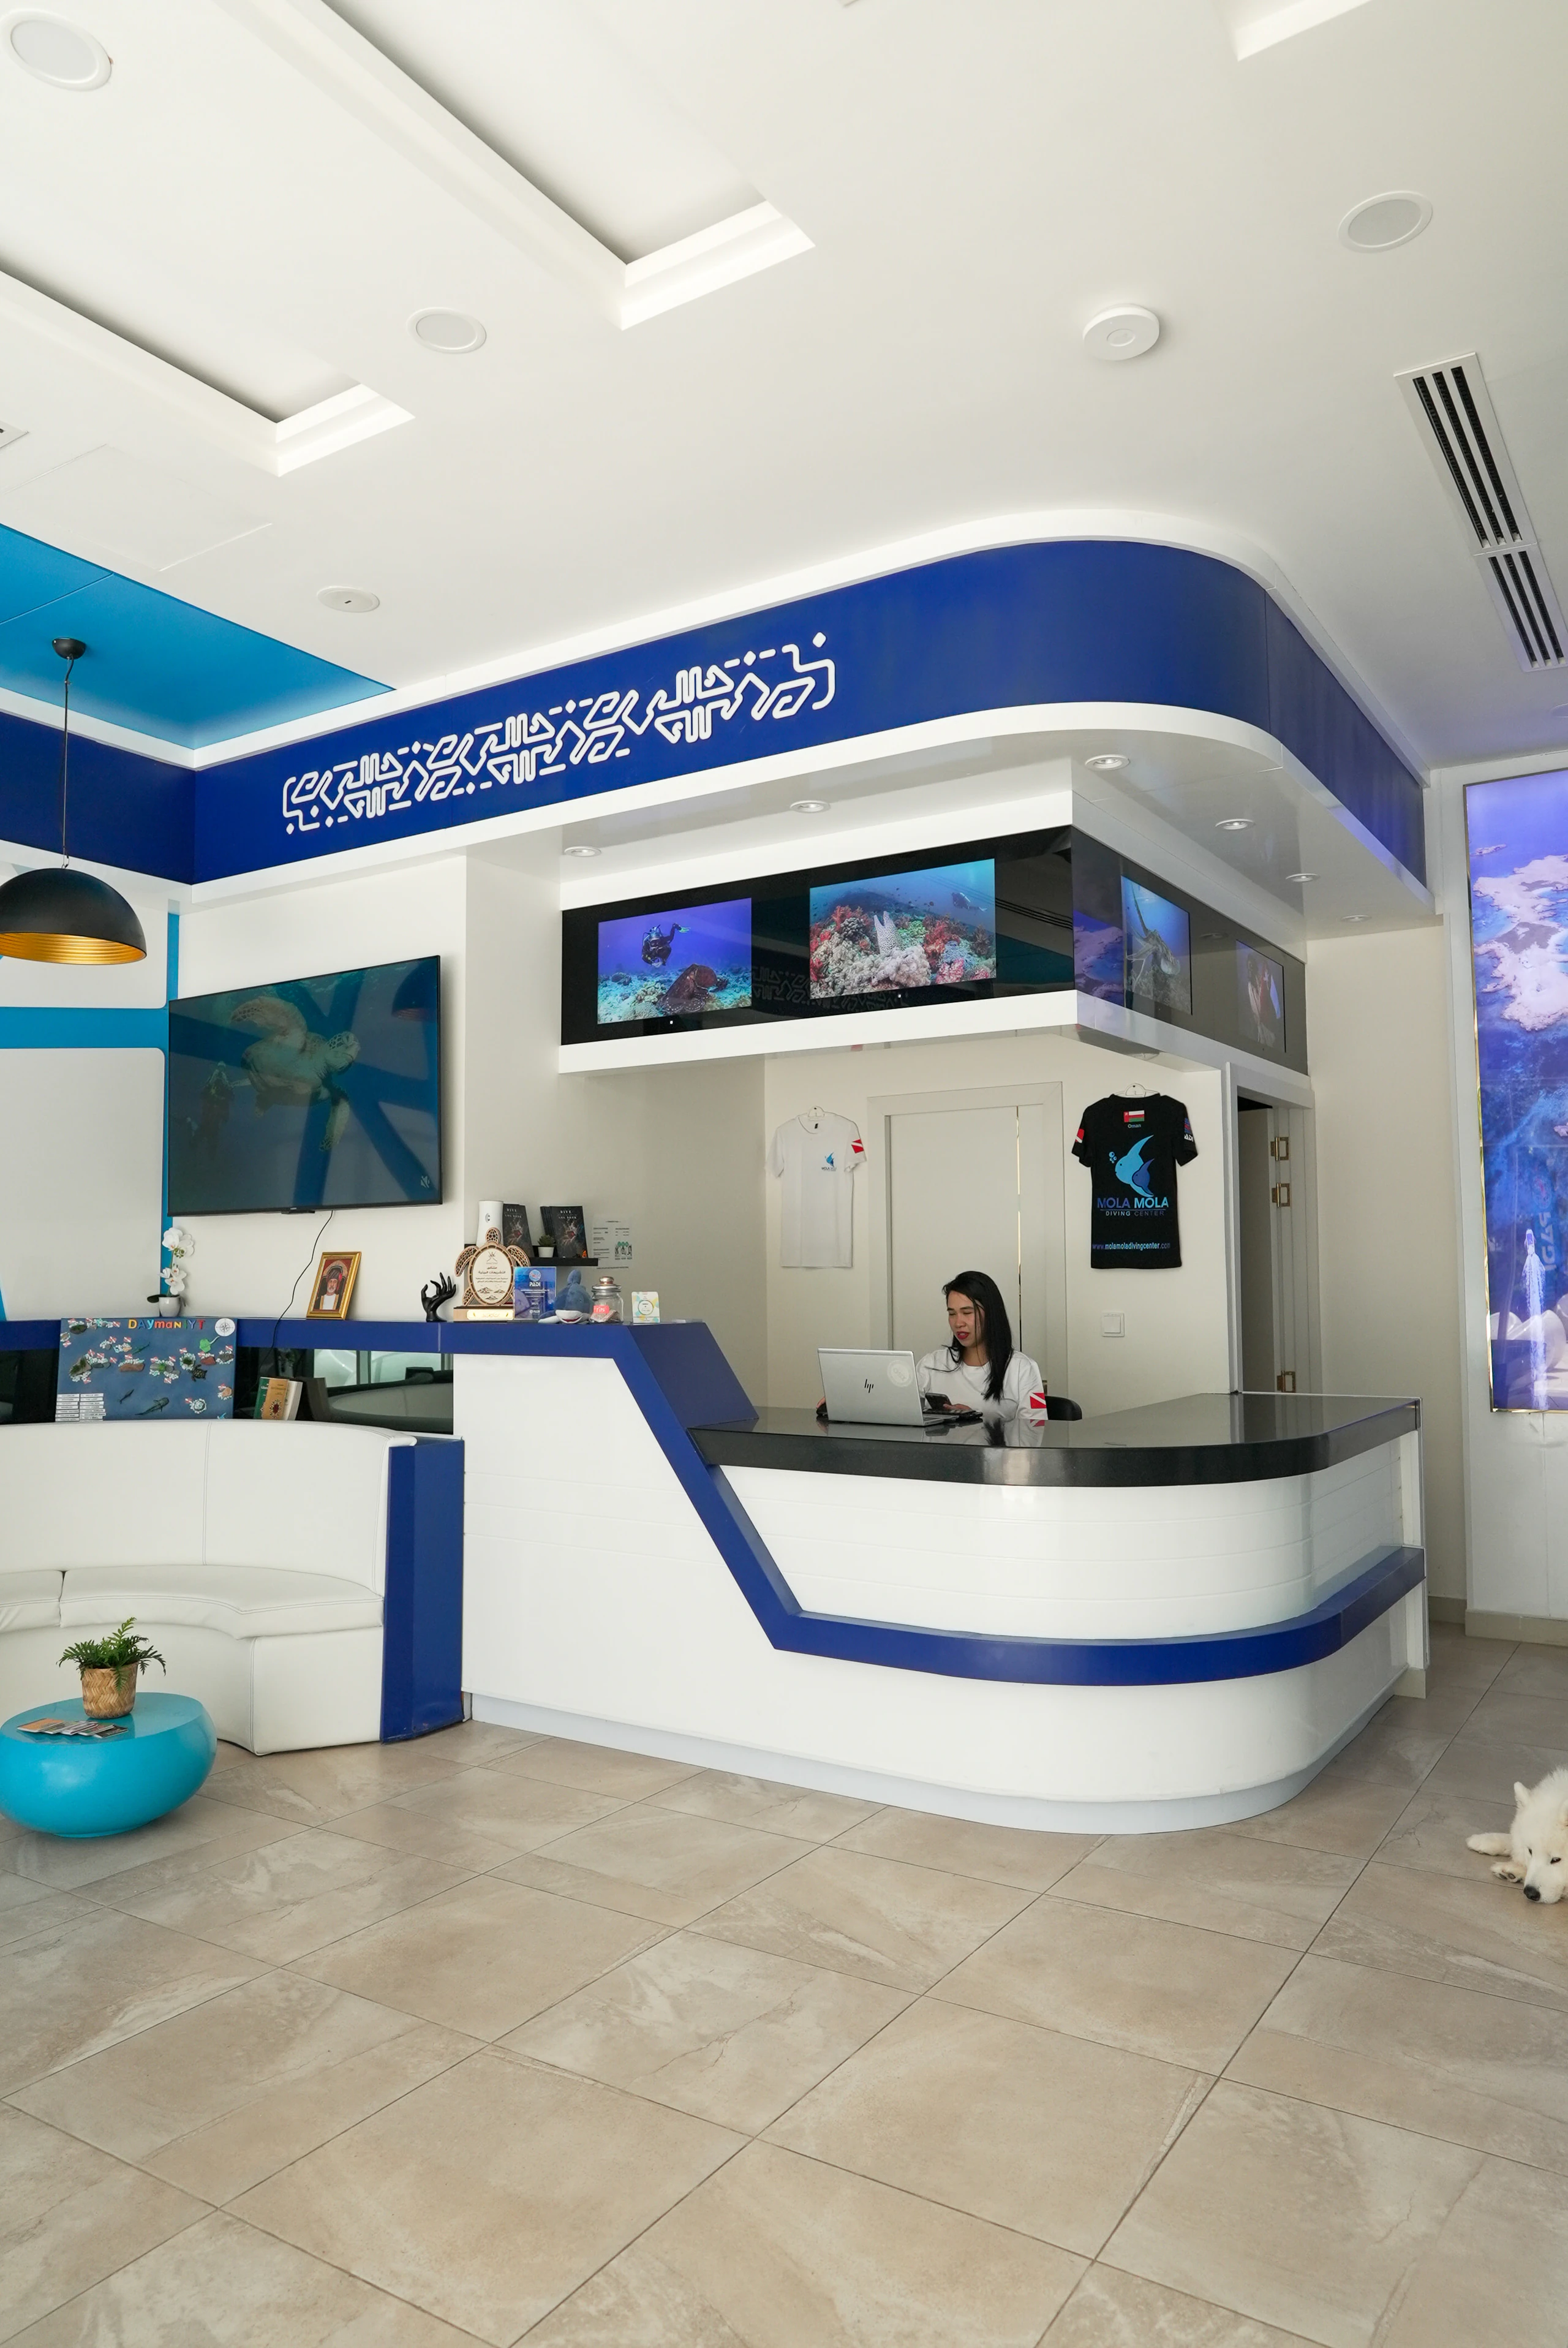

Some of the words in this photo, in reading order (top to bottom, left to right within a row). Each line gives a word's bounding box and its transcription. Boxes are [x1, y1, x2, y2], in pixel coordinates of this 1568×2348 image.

[1097, 1198, 1131, 1208] MOLA
[1134, 1197, 1169, 1208] MOLA
[864, 1378, 874, 1394] hp
